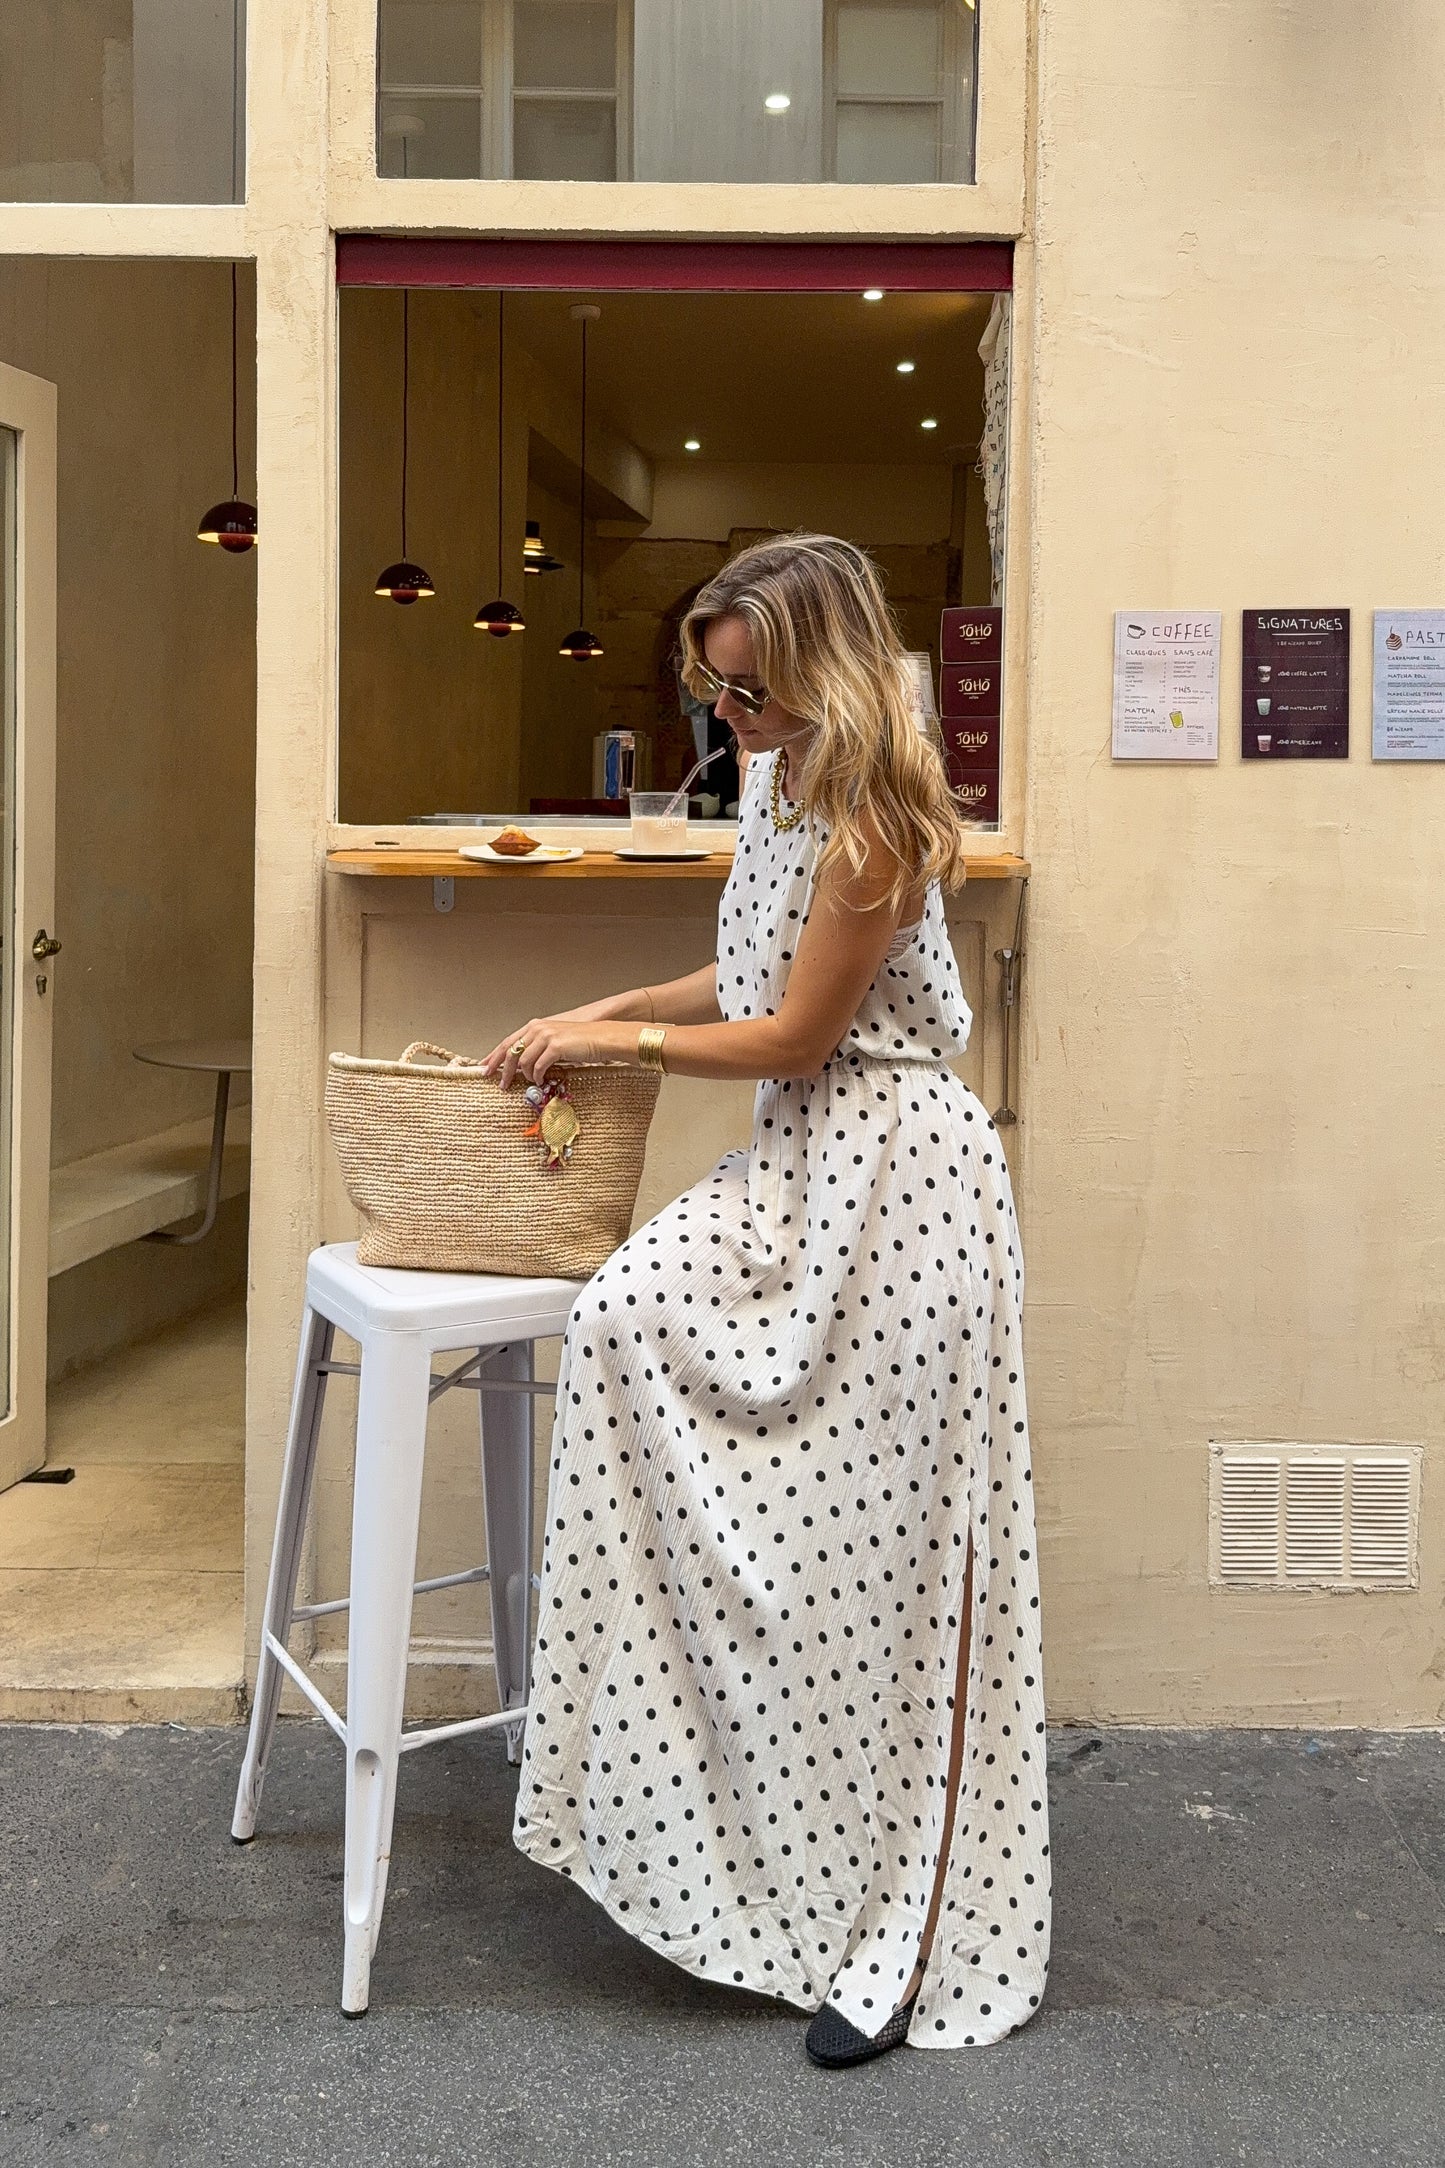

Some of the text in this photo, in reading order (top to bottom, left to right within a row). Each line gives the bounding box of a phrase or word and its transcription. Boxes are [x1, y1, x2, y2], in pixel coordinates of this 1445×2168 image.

[1257, 616, 1343, 631] SIGNATURES
[1152, 622, 1214, 640] COFFEE
[1173, 649, 1195, 657] SANS
[1124, 707, 1156, 715] MATCHA
